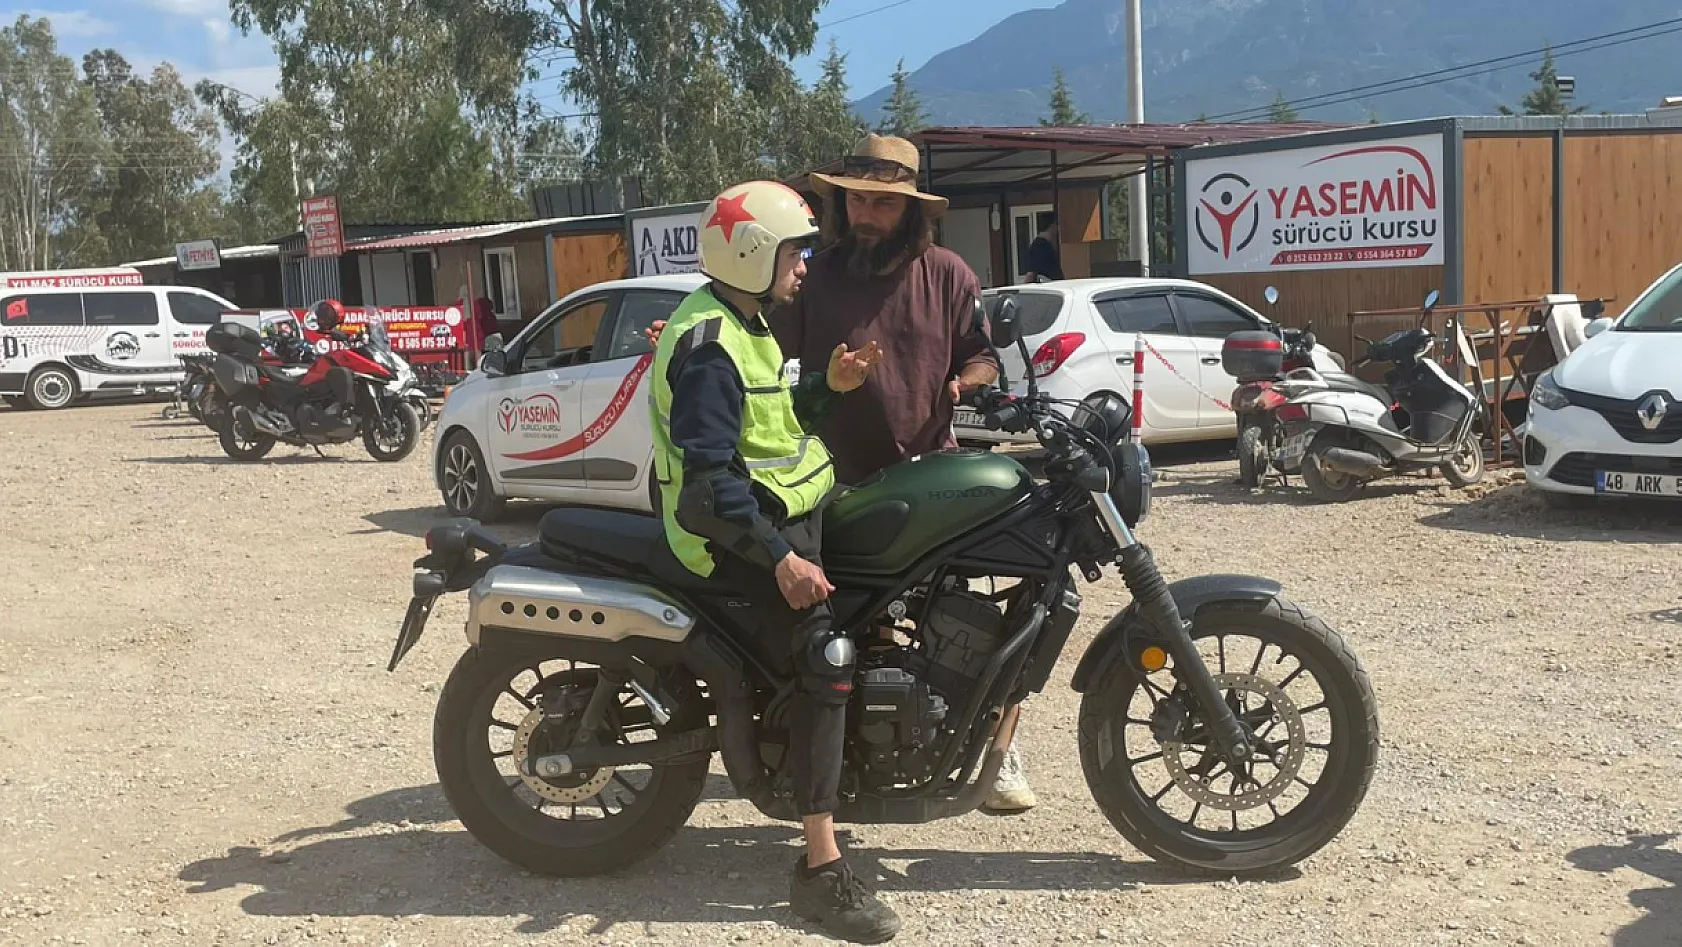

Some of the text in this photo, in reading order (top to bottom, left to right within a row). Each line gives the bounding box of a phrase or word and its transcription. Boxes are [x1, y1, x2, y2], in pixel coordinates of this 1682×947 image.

[1267, 168, 1437, 220] YASEMİN
[1272, 217, 1437, 246] sürücü kursu
[1286, 254, 1292, 263] 0
[1357, 251, 1362, 259] 0
[1363, 250, 1378, 259] 554
[1395, 249, 1405, 258] 57
[12, 278, 56, 288] YILMAZ
[413, 309, 444, 321] KURSU
[1605, 474, 1623, 491] 48
[1635, 475, 1662, 494] ARK
[928, 488, 996, 500] HONDA
